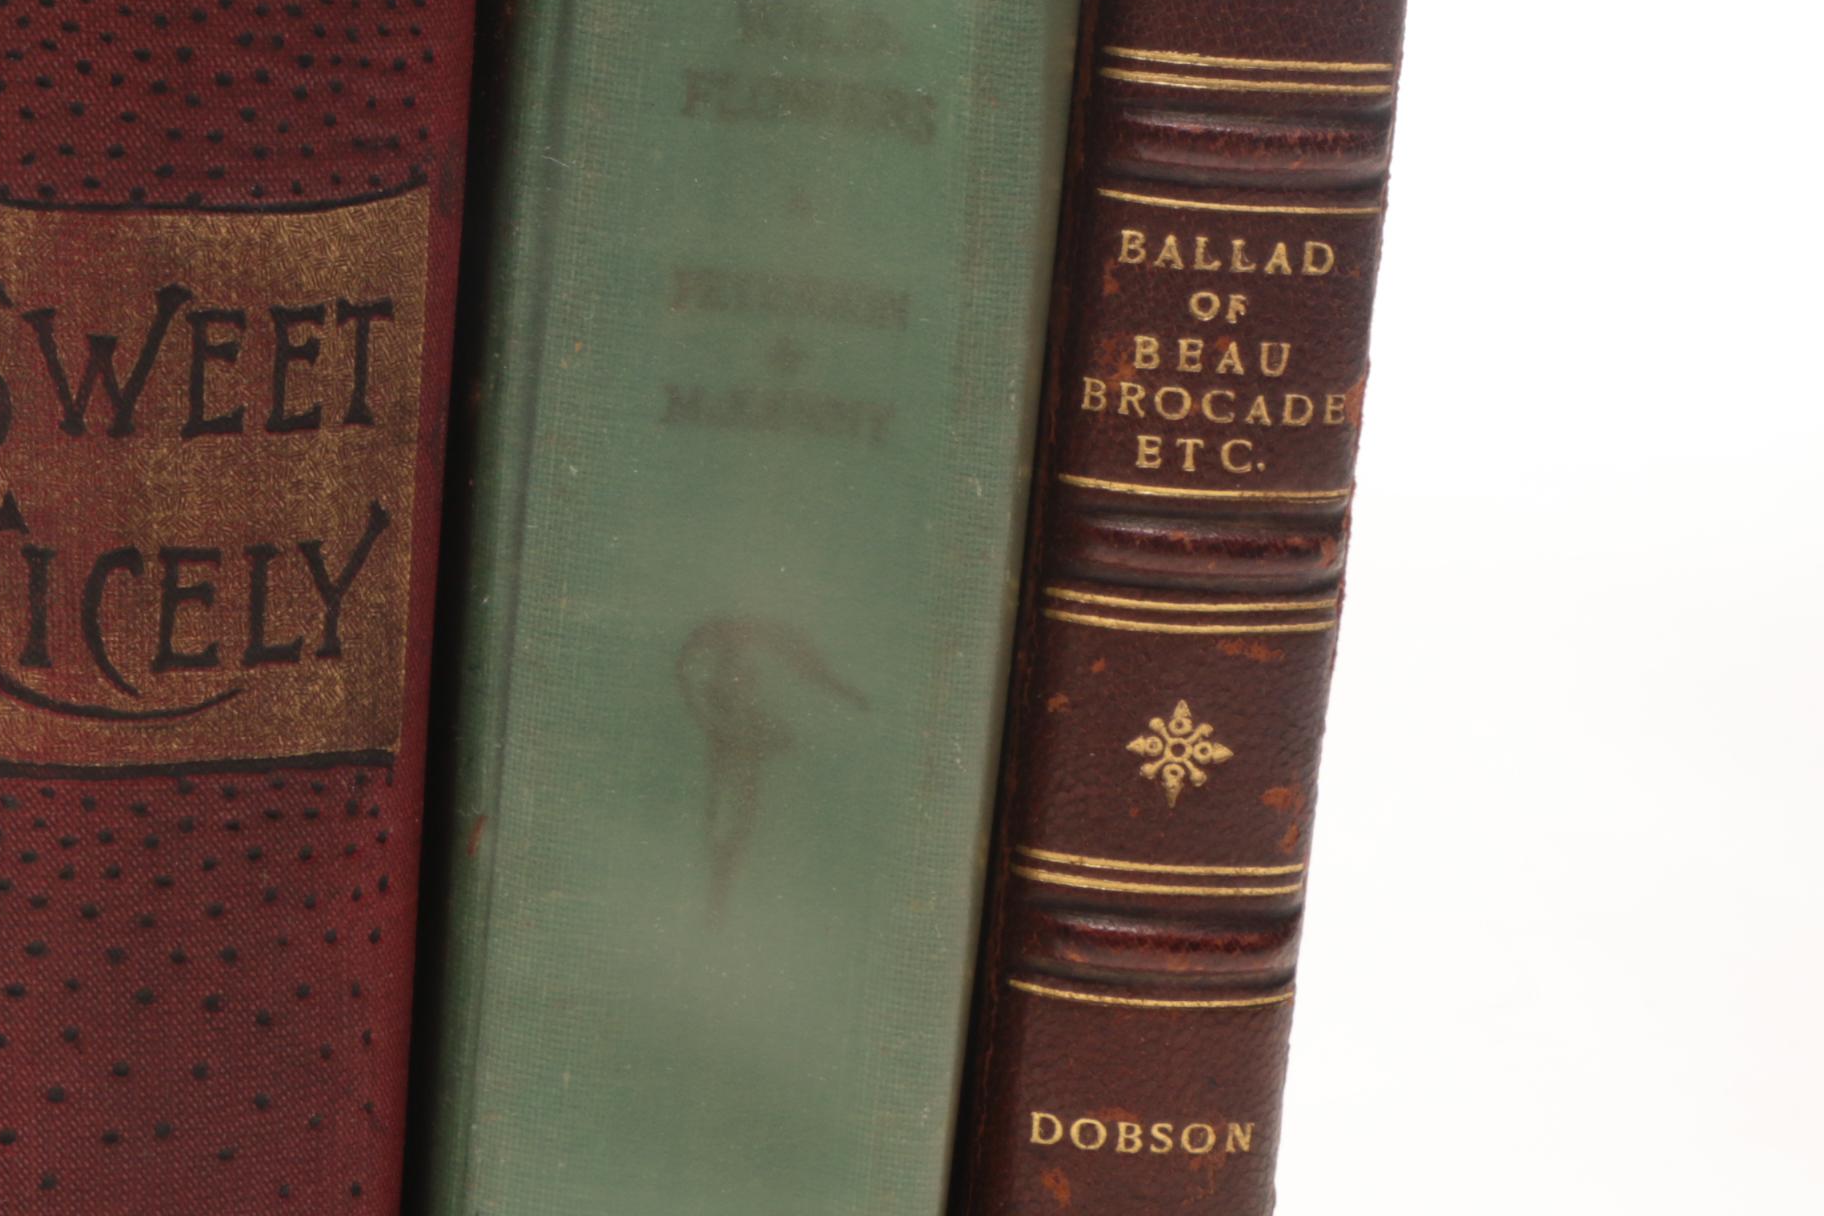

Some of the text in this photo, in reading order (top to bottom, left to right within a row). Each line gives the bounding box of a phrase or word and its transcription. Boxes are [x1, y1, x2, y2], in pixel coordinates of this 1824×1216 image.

[1117, 229, 1336, 276] BALLAD
[1188, 291, 1250, 324] OF
[1133, 335, 1292, 377] BEAU
[1081, 377, 1347, 426] BROCADE
[1135, 435, 1267, 474] ETC.
[1029, 1111, 1255, 1154] DOBSON
